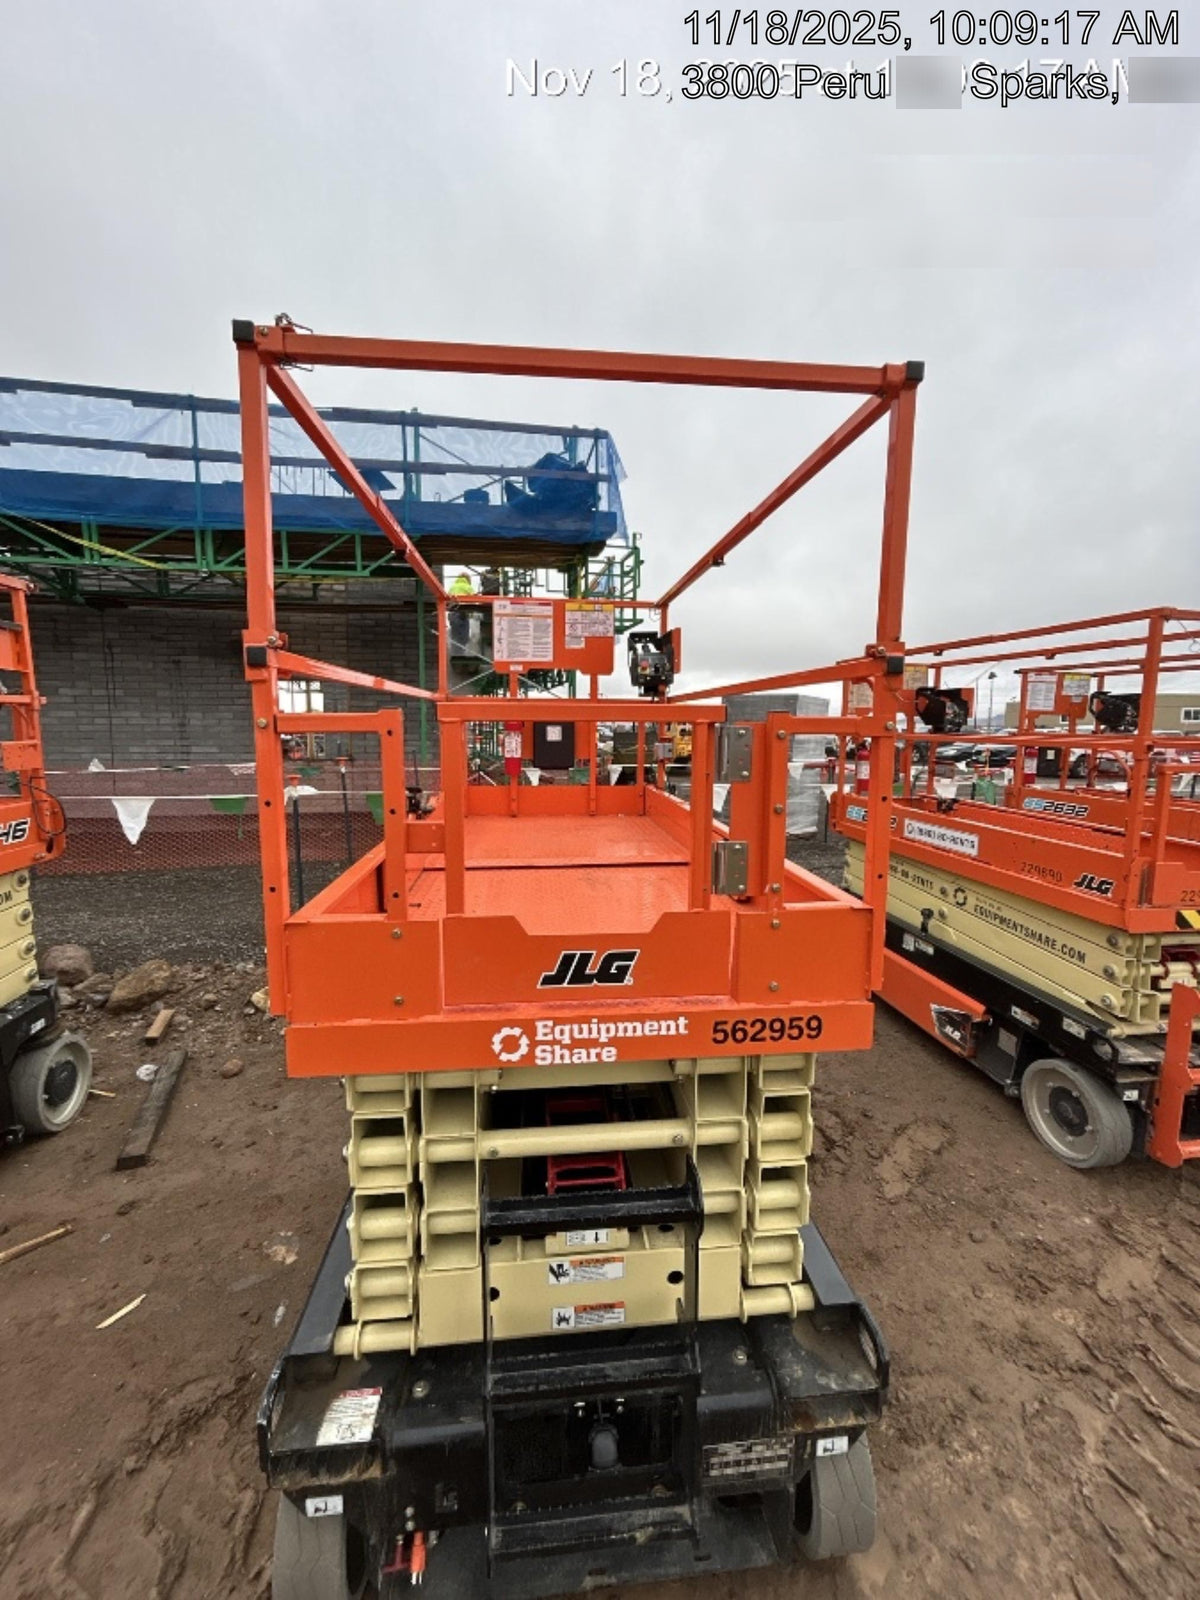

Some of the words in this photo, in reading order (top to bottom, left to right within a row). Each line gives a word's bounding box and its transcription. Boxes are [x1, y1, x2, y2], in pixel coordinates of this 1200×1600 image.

[1074, 873, 1114, 897] JLG
[974, 904, 1087, 964] EQUIPMENTSHARE.COM
[537, 949, 640, 988] JLG
[534, 1015, 689, 1043] Equipment
[712, 1015, 823, 1045] 562959
[534, 1044, 617, 1066] Share
